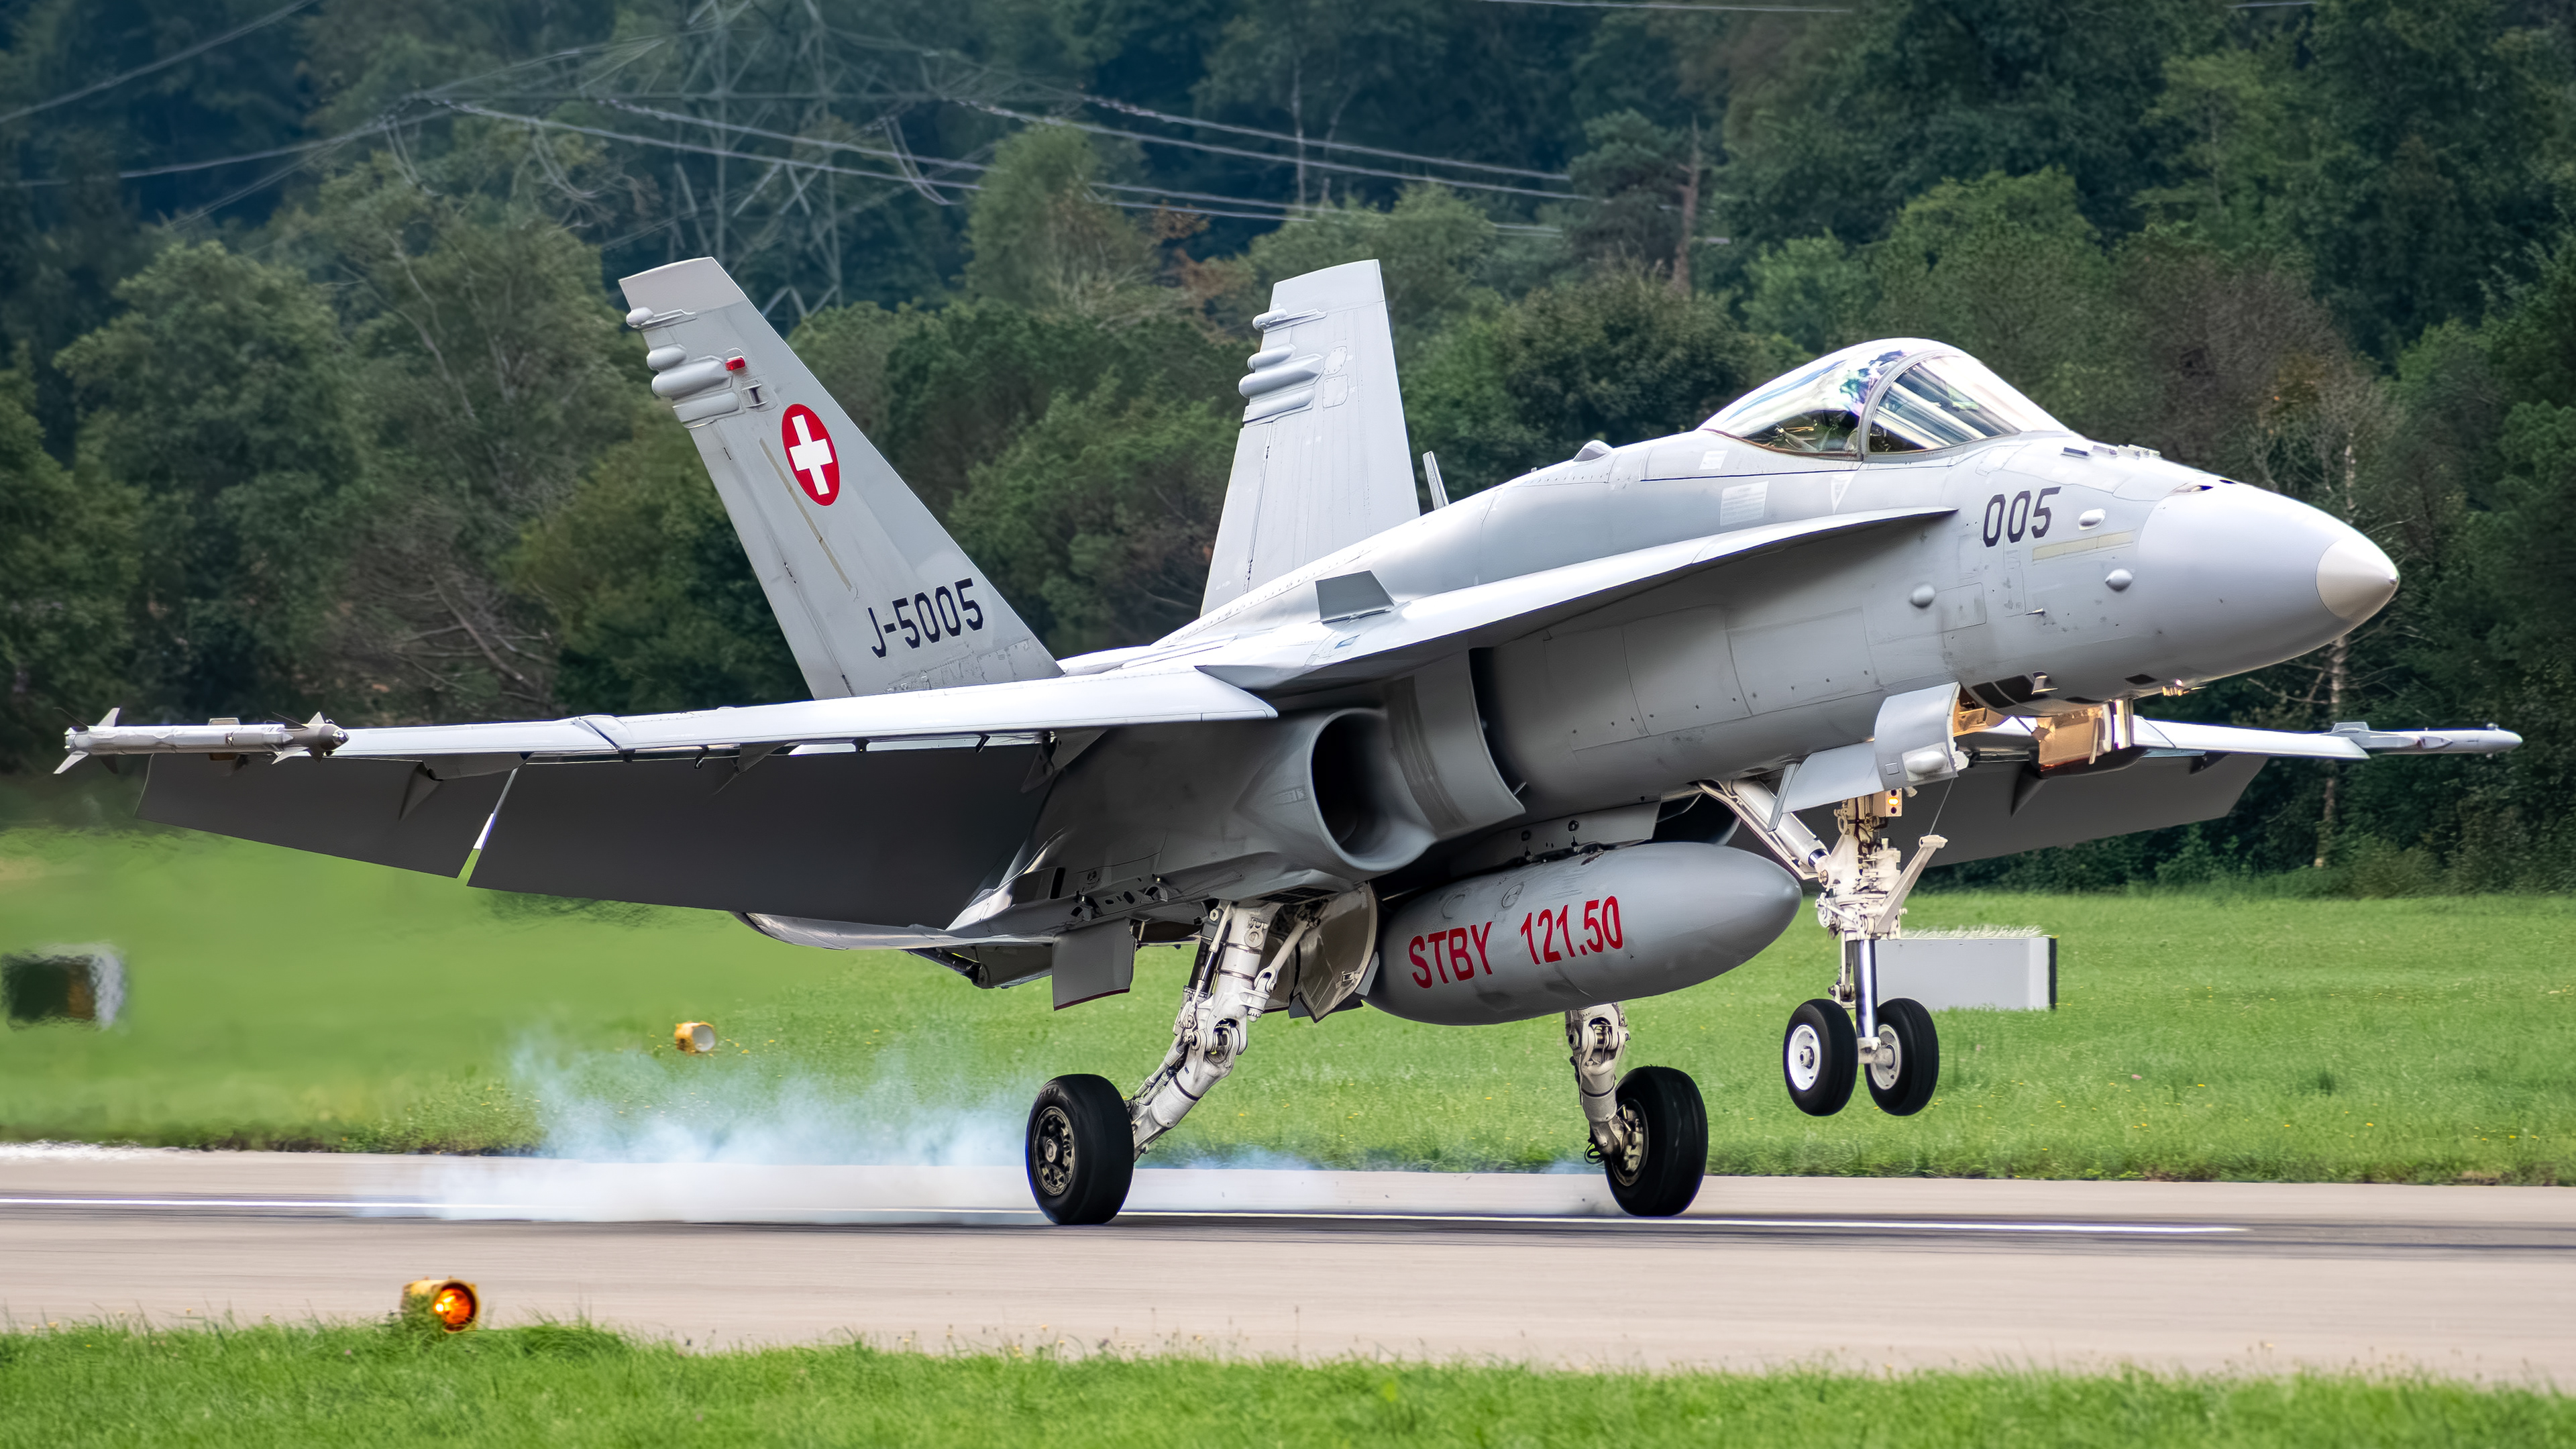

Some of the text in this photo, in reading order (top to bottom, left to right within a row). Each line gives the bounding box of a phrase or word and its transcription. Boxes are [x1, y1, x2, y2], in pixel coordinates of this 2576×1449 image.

[1983, 487, 2061, 547] 005
[867, 578, 983, 658] J-5005
[1409, 896, 1623, 989] STBY 121.50
